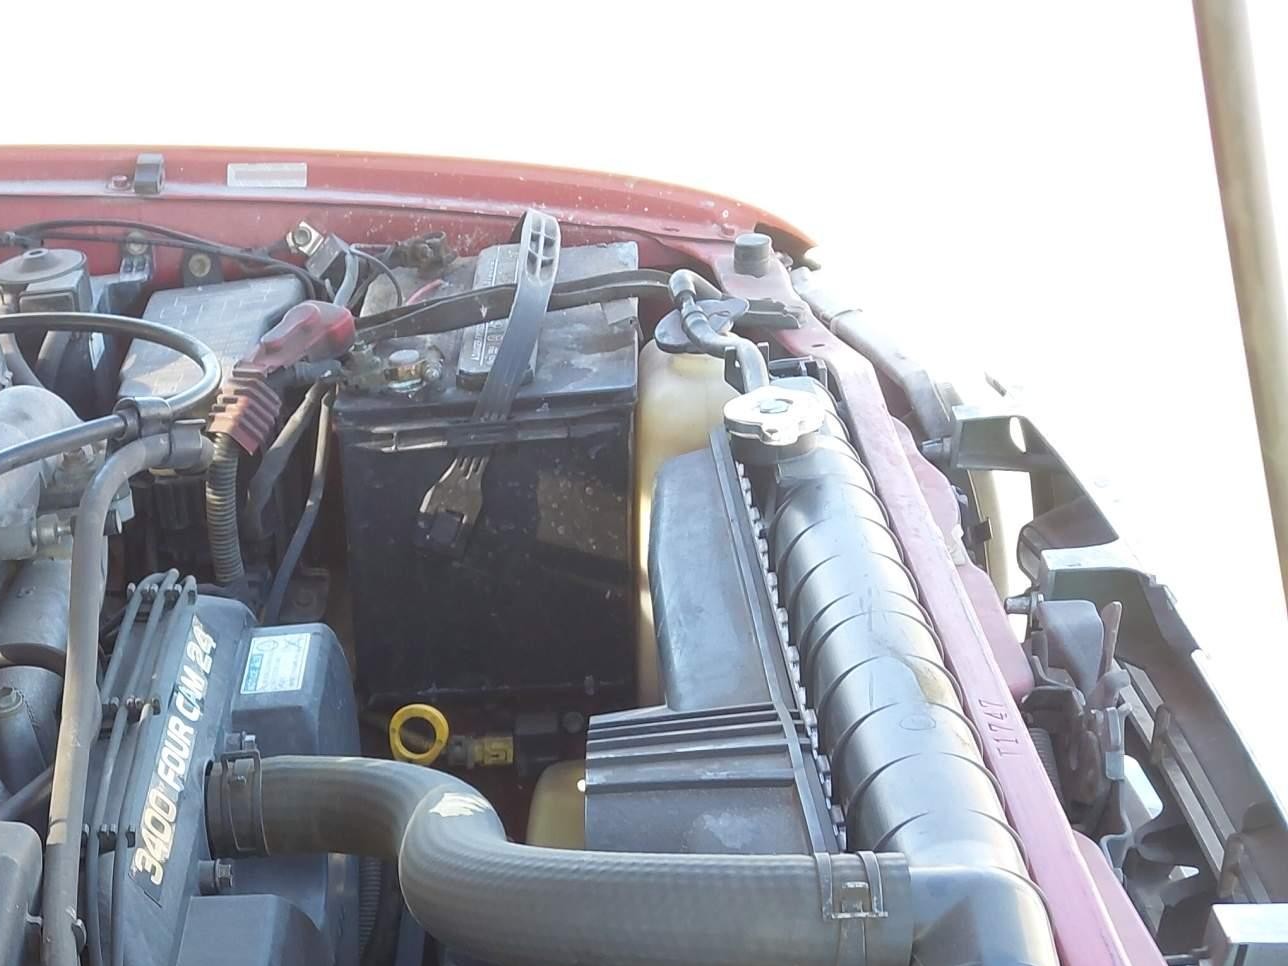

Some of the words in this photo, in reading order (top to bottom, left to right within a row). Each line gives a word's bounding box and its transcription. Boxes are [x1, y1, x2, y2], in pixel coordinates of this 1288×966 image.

[186, 616, 217, 674] 24
[176, 665, 208, 722] CAM
[157, 718, 195, 792] FOUR
[979, 699, 1023, 757] T1747
[133, 787, 177, 886] 3400
